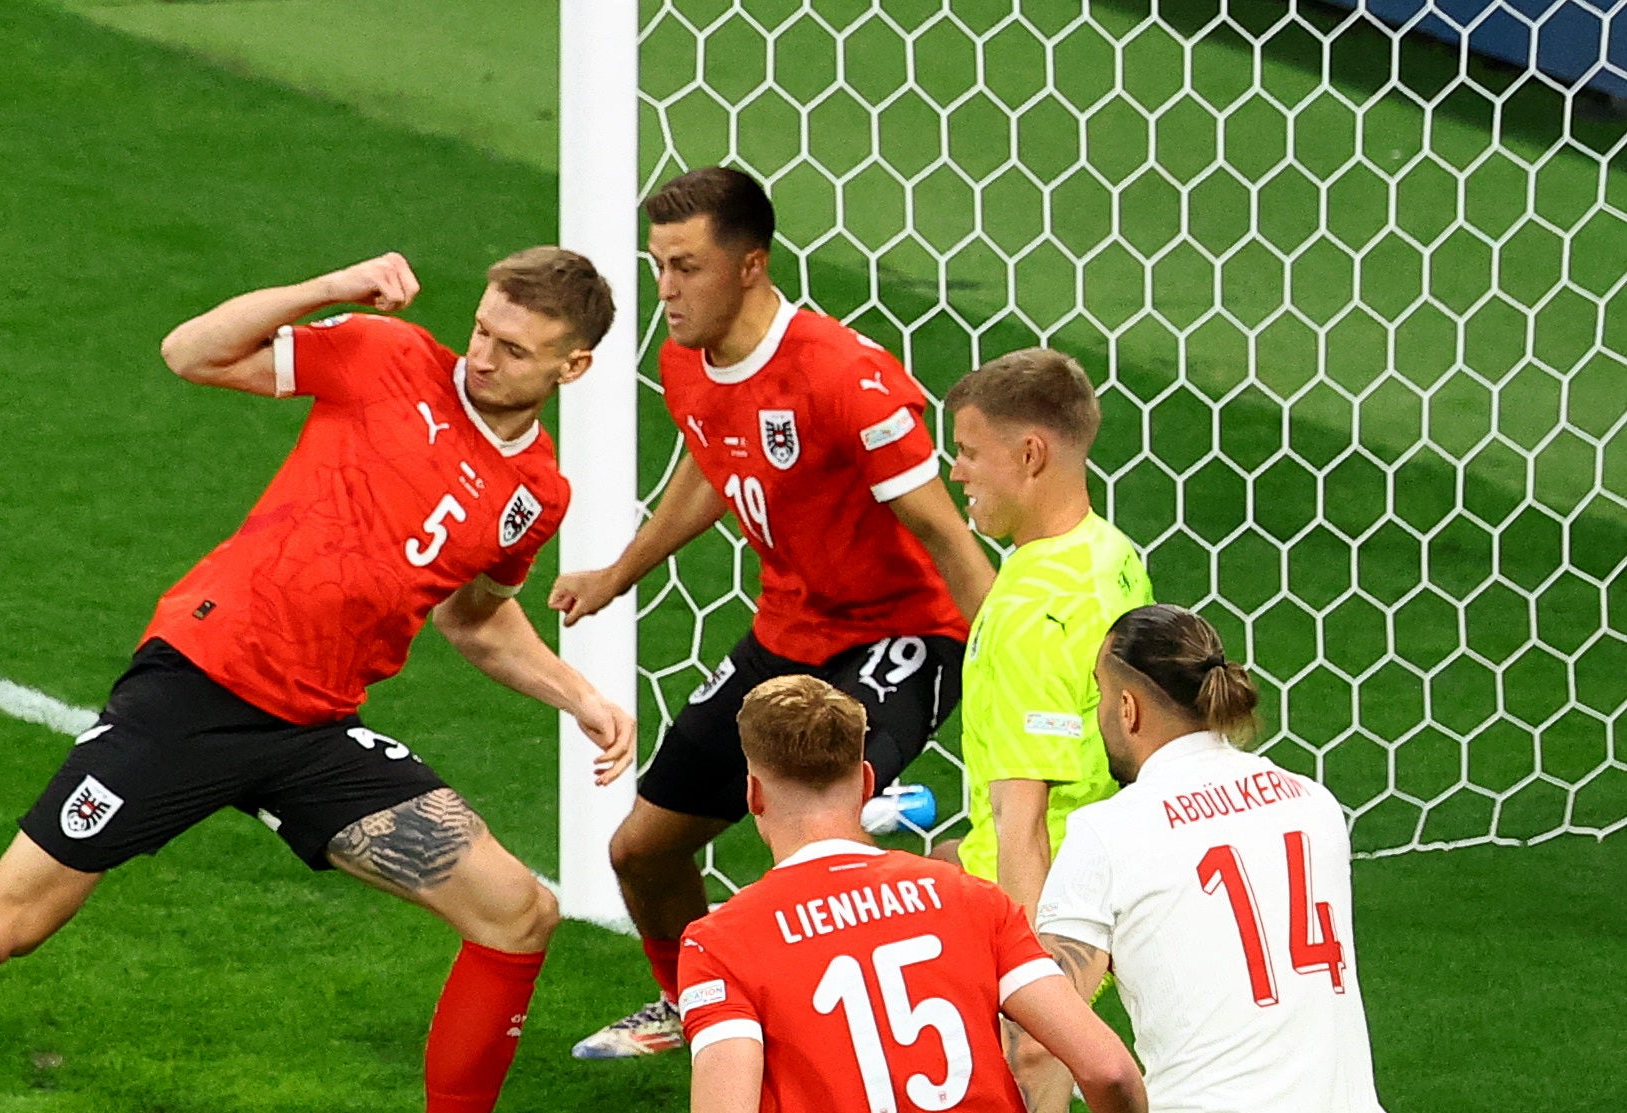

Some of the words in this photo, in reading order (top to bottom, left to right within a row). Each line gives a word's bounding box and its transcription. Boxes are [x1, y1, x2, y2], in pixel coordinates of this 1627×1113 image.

[404, 494, 466, 567] 5
[724, 473, 774, 549] 19
[859, 635, 928, 685] 19
[775, 877, 943, 944] LIENHART
[1196, 831, 1347, 1008] 14
